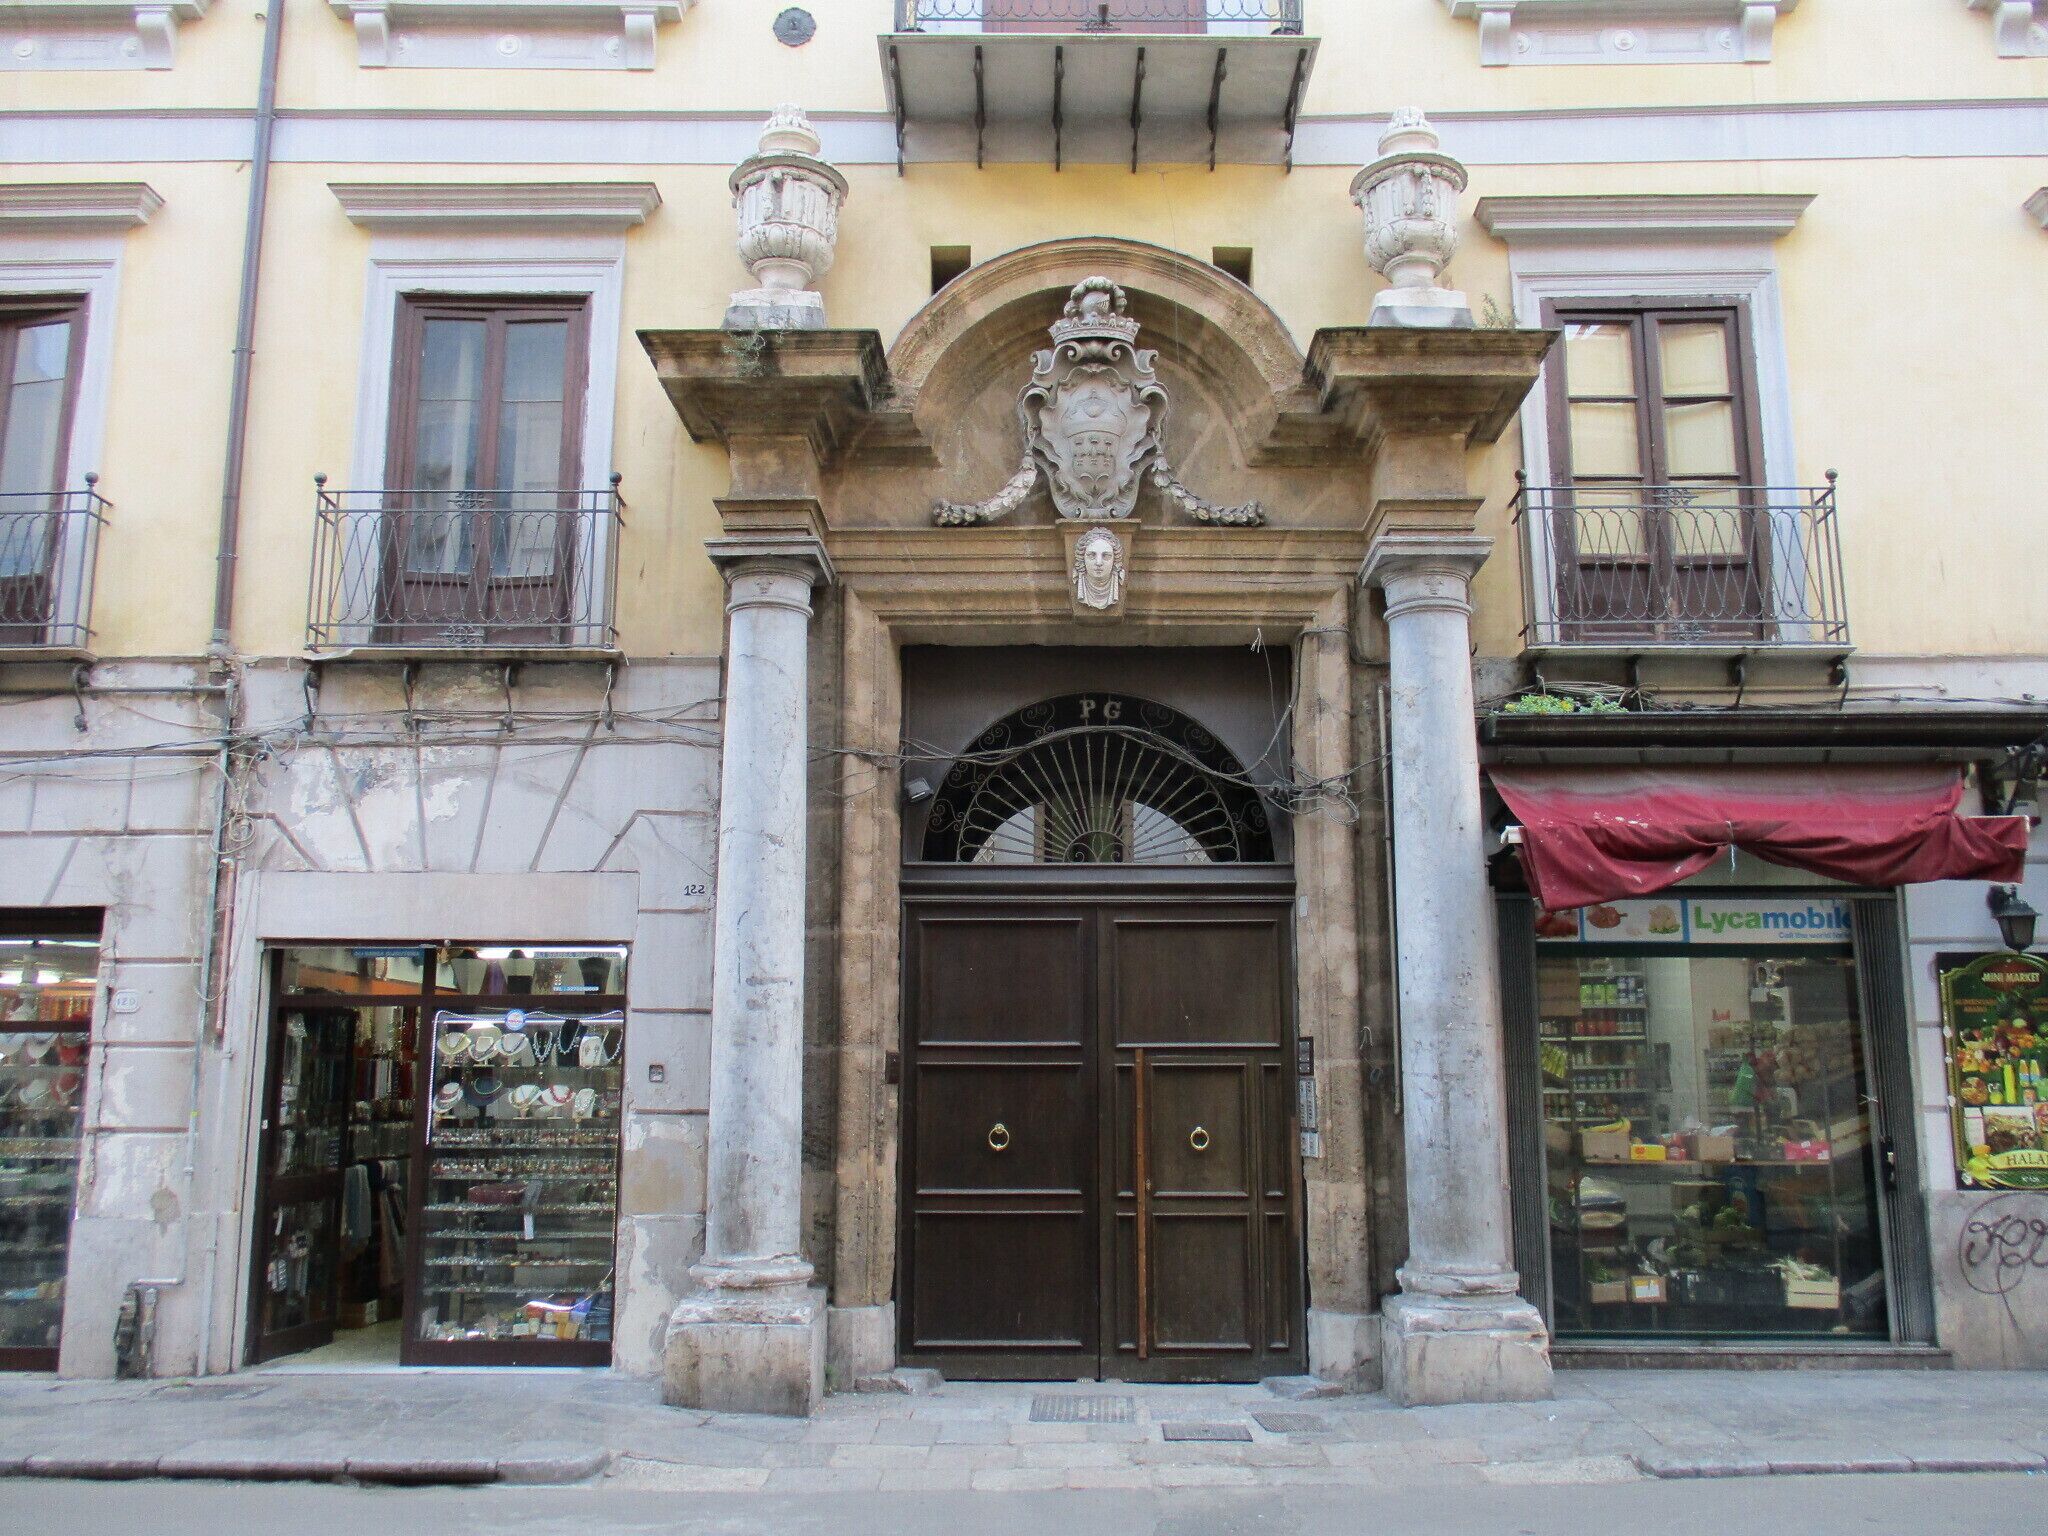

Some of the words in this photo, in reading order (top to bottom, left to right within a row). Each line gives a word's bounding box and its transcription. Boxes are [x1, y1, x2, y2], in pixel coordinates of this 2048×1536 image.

[684, 884, 706, 896] 122
[1982, 972, 2004, 982] MINI
[2006, 972, 2040, 982] MARKET
[2007, 1153, 2048, 1165] HALA
